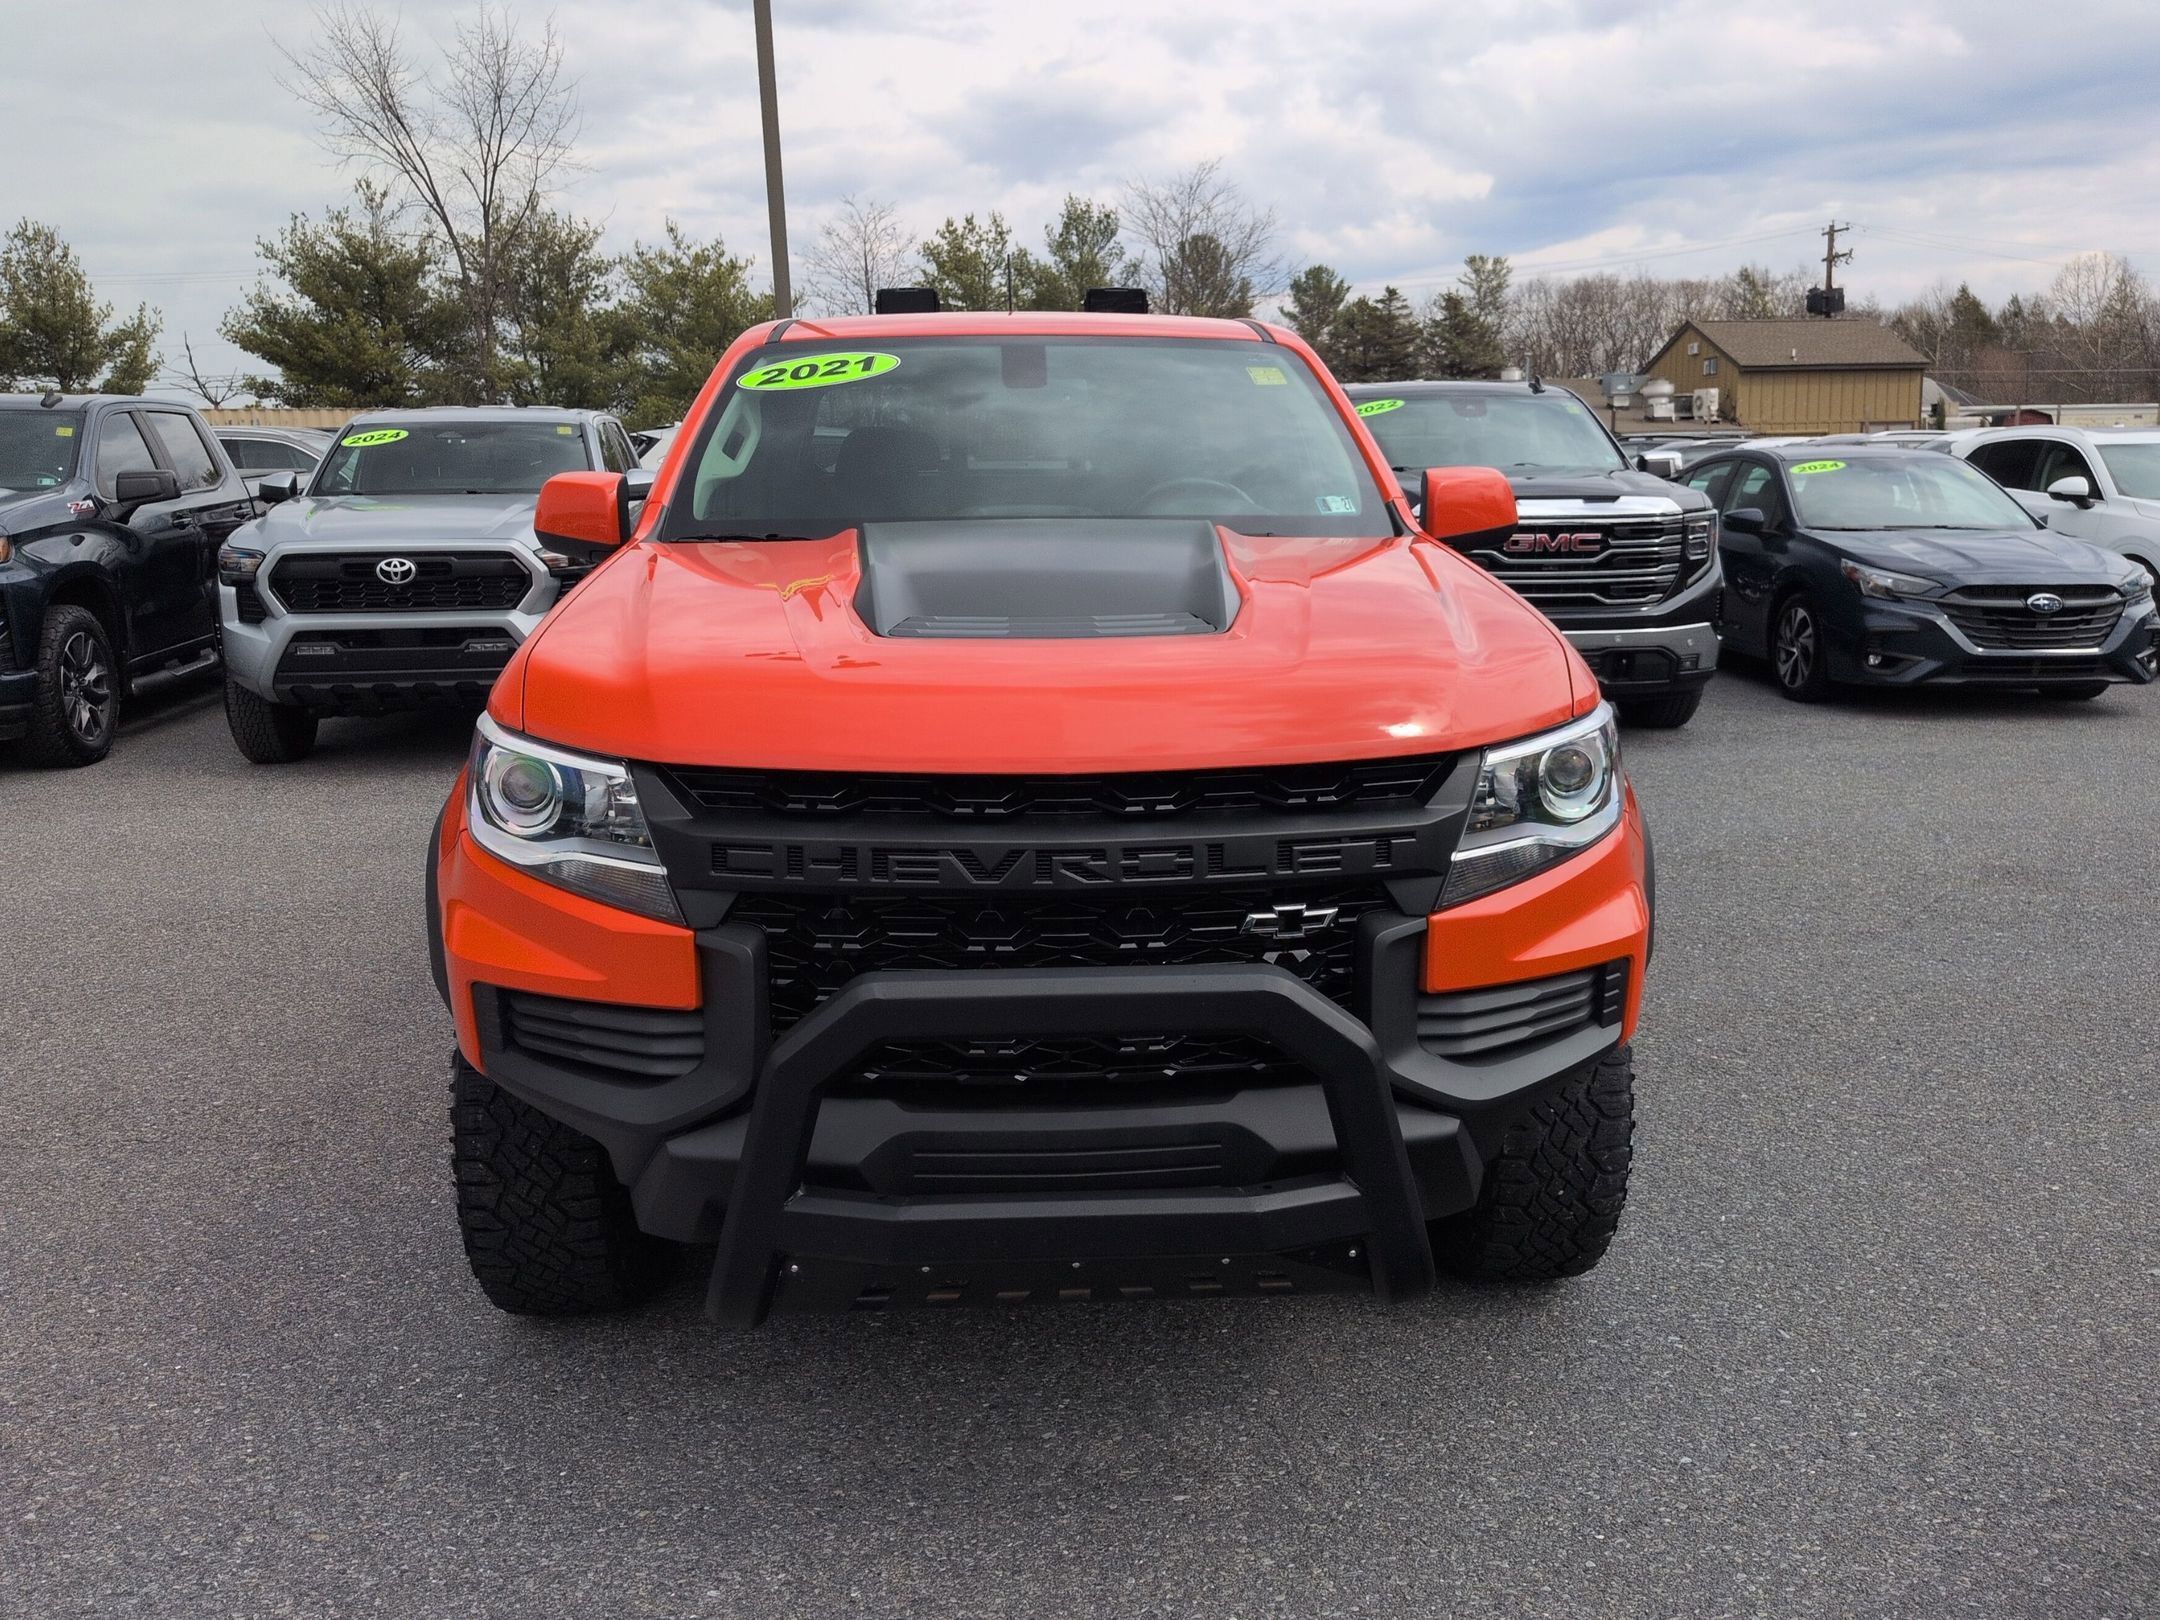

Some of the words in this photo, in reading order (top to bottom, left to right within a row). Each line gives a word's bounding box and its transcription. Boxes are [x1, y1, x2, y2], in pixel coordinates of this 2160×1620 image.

[756, 355, 877, 386] 2021
[348, 431, 402, 445] 2024
[1797, 462, 1840, 473] 2024
[1503, 533, 1602, 552] GMC
[710, 830, 1417, 885] CHEVROLET
